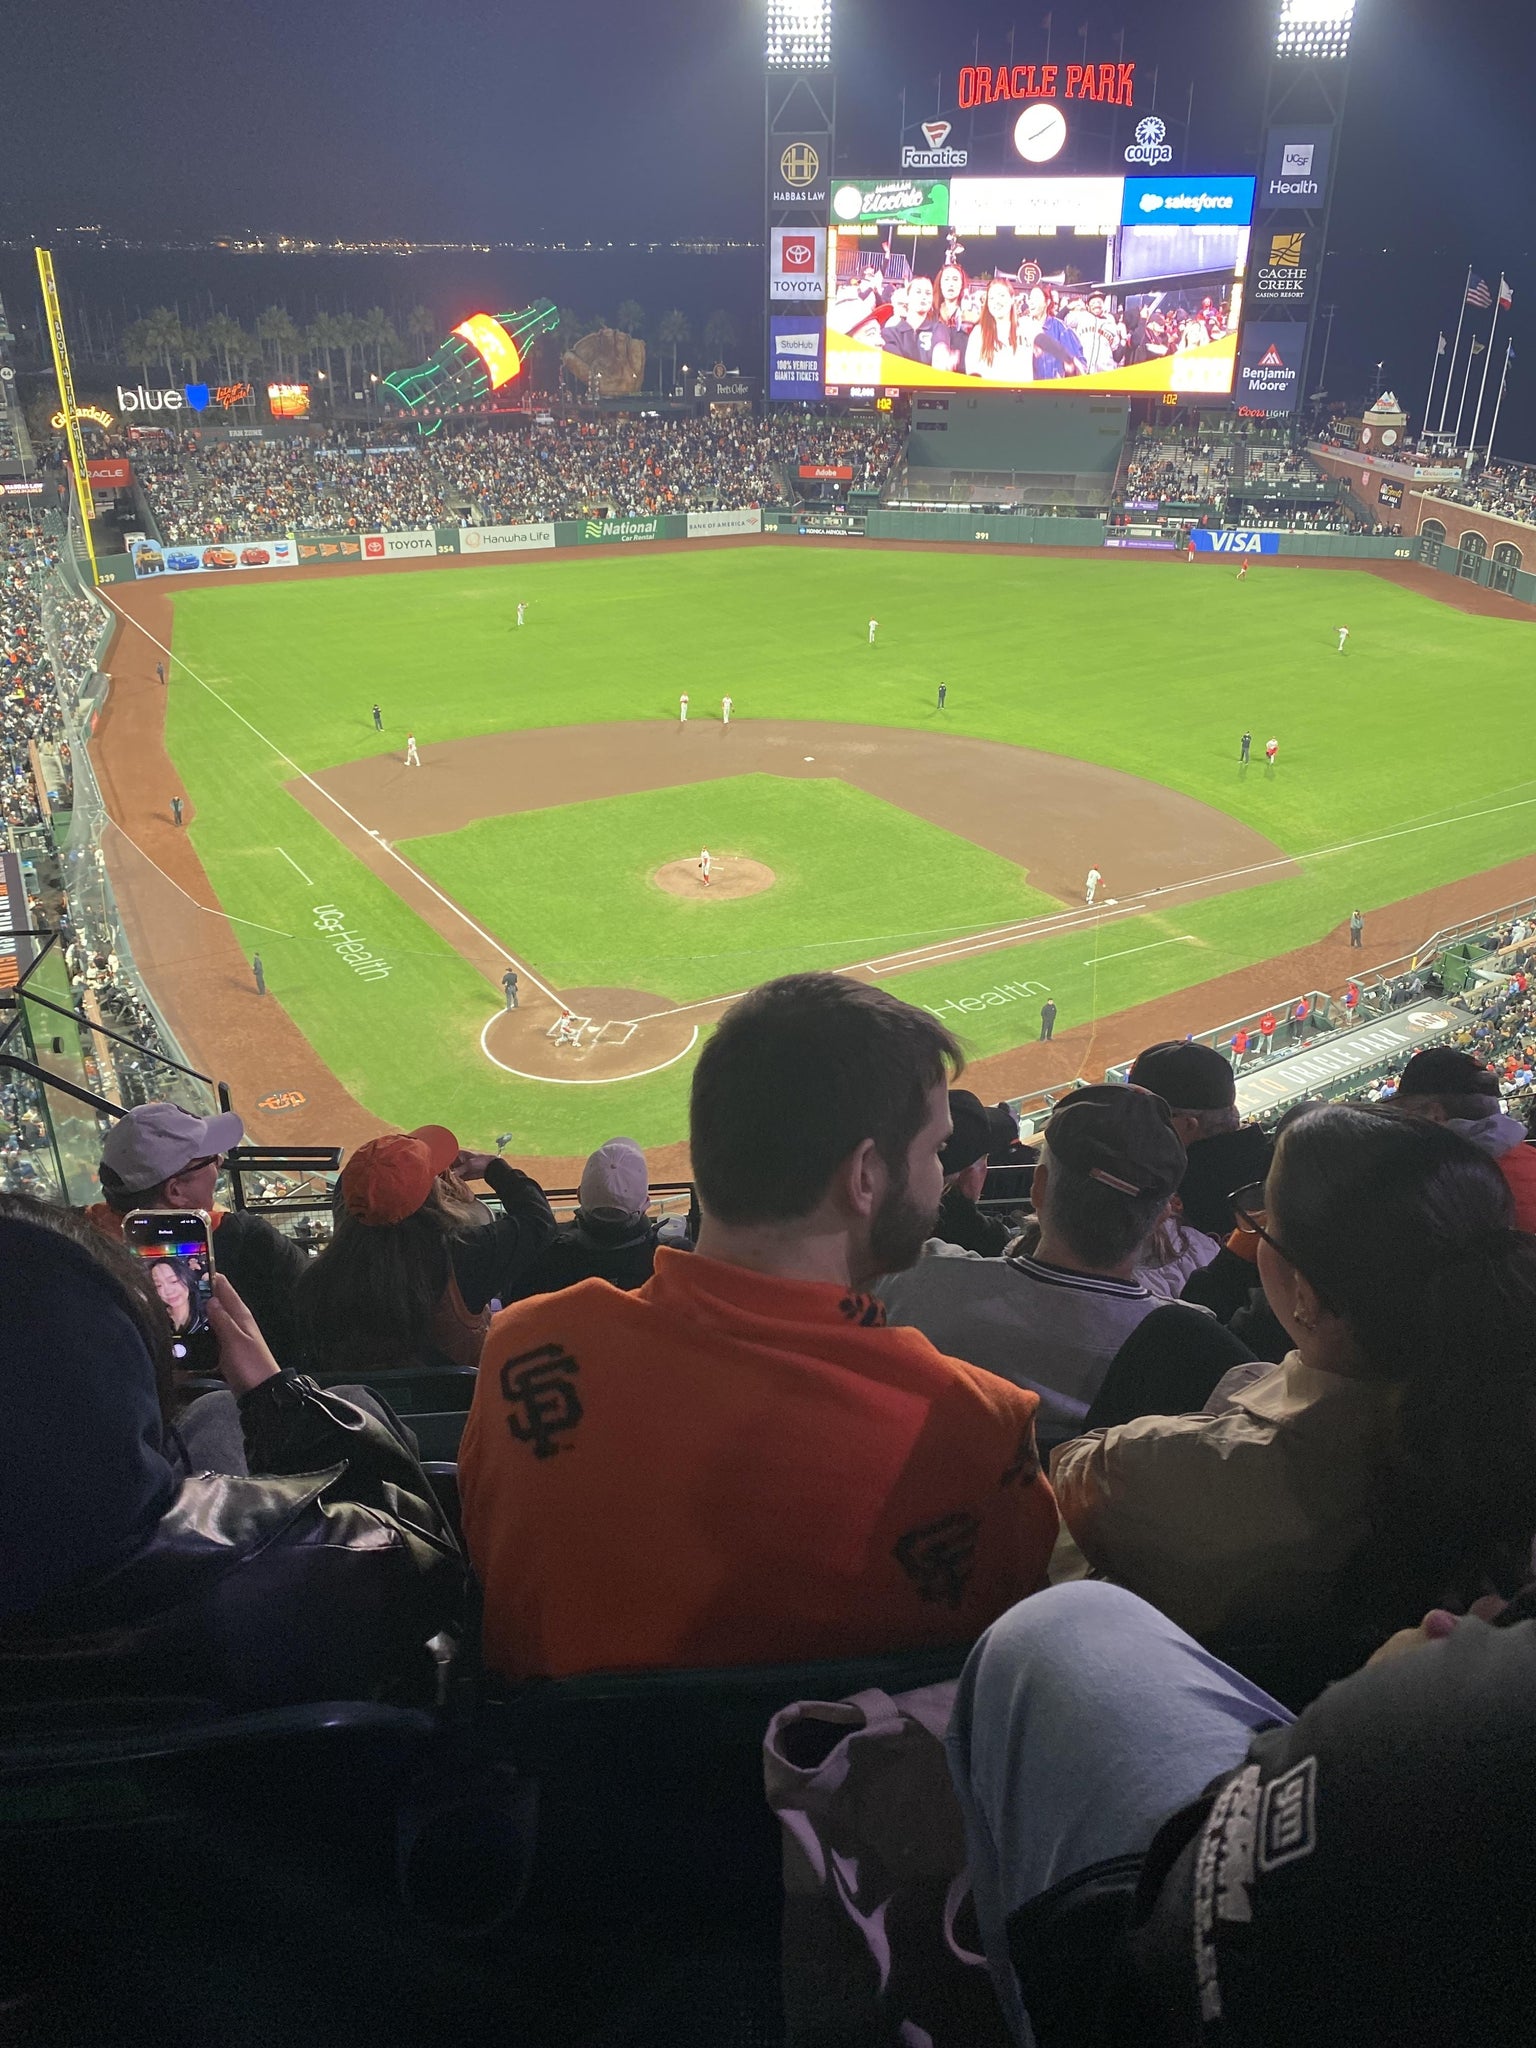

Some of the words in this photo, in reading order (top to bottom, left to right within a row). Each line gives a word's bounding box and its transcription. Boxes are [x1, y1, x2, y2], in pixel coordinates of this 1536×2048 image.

[958, 64, 1058, 109] ORACLE
[1065, 63, 1135, 107] PARK
[903, 147, 966, 166] Fanatics
[1126, 145, 1171, 164] coupa
[1286, 154, 1309, 166] UCSF
[1269, 180, 1318, 194] Health
[773, 191, 806, 201] HABBAS
[807, 191, 826, 201] LAW
[1164, 192, 1233, 213] salesforce
[1258, 268, 1307, 279] CACHE
[773, 281, 822, 292] TOYOTA
[1258, 279, 1304, 290] CREEK
[780, 340, 814, 350] StubHub
[776, 360, 792, 370] 100%
[792, 360, 818, 371] VERIFIED
[774, 371, 795, 381] GIANTS
[796, 371, 819, 382] TICKETS
[1242, 366, 1296, 381] Benjamin
[731, 383, 749, 394] Coffee
[1248, 380, 1286, 391] Moore
[117, 385, 183, 412] blue
[876, 398, 892, 410] 1:02
[1162, 394, 1178, 405] 1:02
[50, 405, 115, 430] Ghardelli
[1238, 405, 1266, 418] Coors
[1265, 410, 1290, 419] LIGHT
[85, 468, 124, 478] RACLE
[815, 468, 837, 477] Adobe
[602, 519, 657, 536] National
[689, 523, 706, 531] BANK
[717, 520, 746, 528] AMERICA
[764, 523, 778, 532] 399
[1240, 519, 1279, 528] WELCOME
[483, 533, 527, 544] Hanwha
[529, 531, 550, 542] Life
[621, 534, 633, 542] Car
[633, 532, 655, 541] Rental
[806, 528, 825, 536] KONICA
[825, 528, 847, 536] MINOLTA
[975, 532, 989, 540] 391
[388, 539, 433, 550] TOYOTA
[1207, 531, 1262, 553] VISA
[438, 545, 454, 553] 354
[1394, 549, 1410, 558] 415
[98, 574, 115, 584] 339
[312, 904, 345, 931] UCSF
[325, 930, 393, 982] Health
[922, 980, 1051, 1019] Health
[1247, 1077, 1289, 1096] TO
[1278, 1048, 1362, 1085] ORACLE
[1357, 1027, 1411, 1056] PARK
